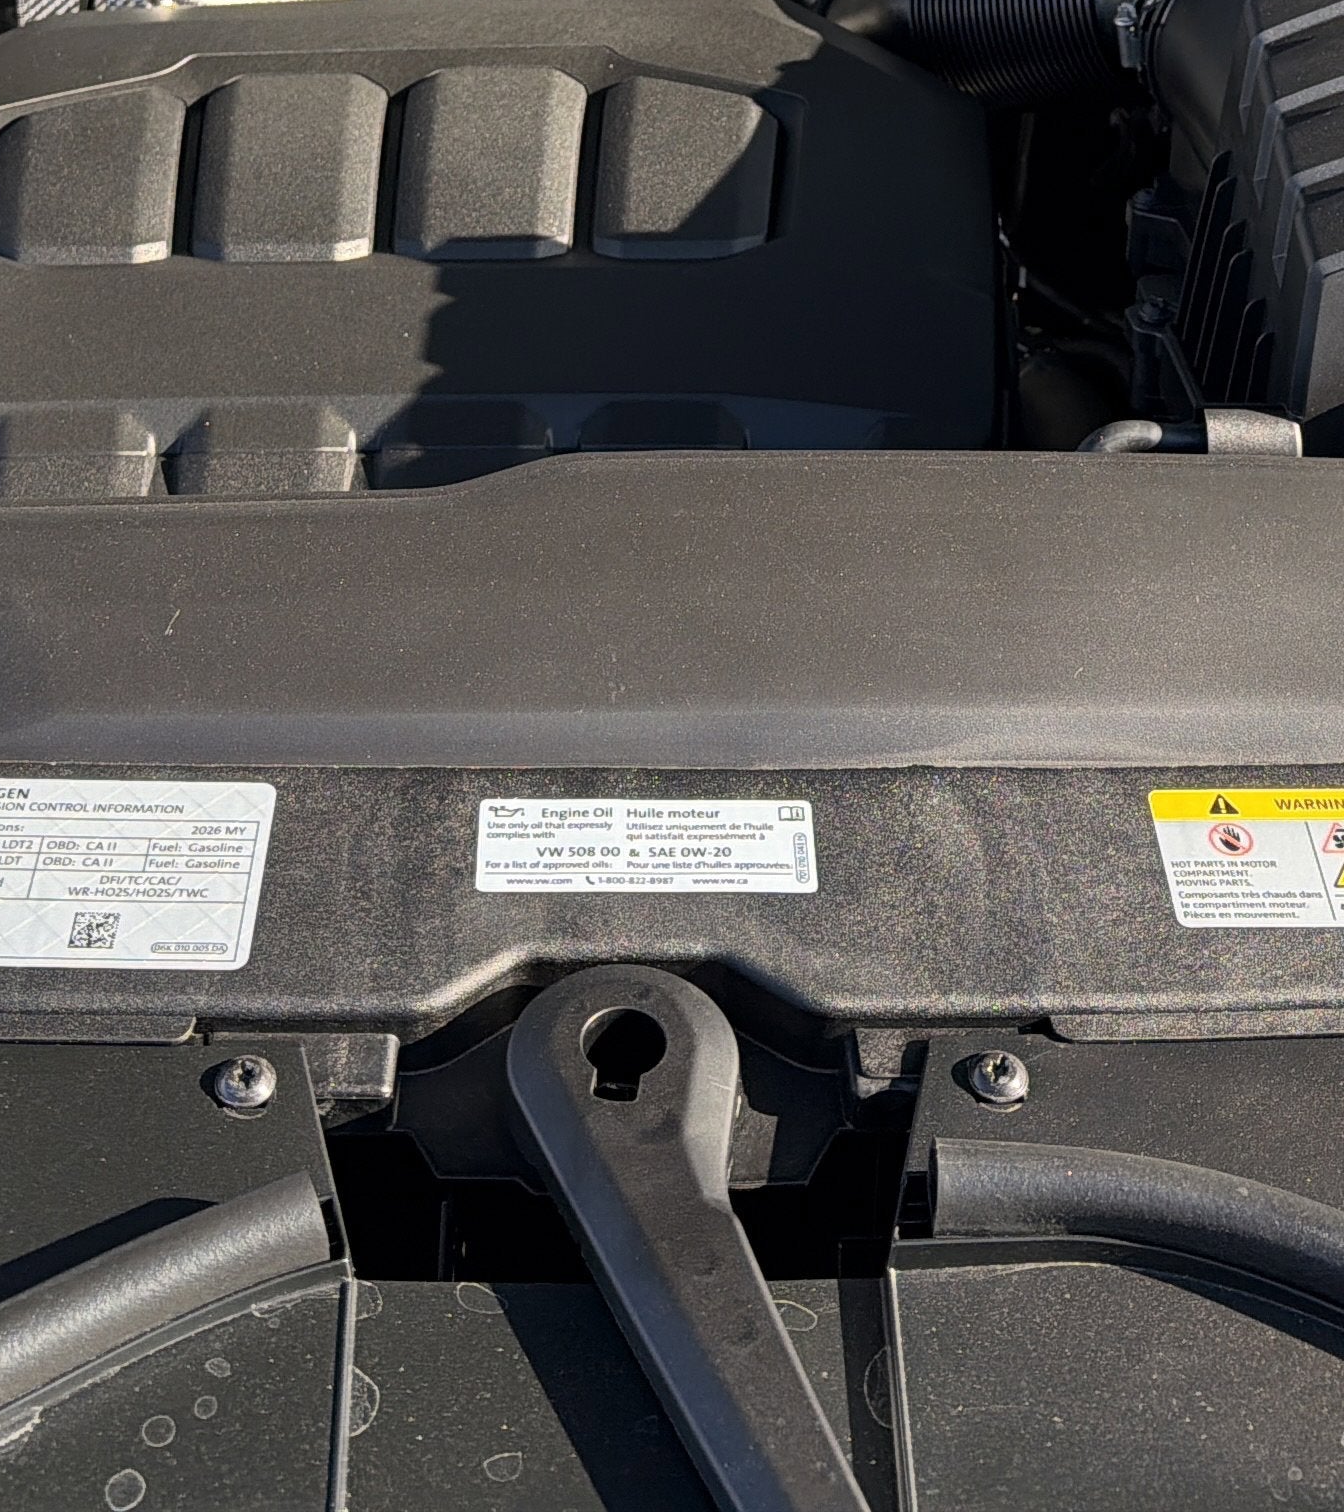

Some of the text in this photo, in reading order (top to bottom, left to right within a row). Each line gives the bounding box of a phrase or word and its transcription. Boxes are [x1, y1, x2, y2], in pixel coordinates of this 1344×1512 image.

[29, 802, 88, 813] CONTROL
[92, 804, 185, 814] INFORMATION
[626, 808, 720, 818] Huile moteur
[542, 807, 613, 820] Engine Oil
[191, 826, 247, 836] 2026 MY
[487, 821, 613, 831] Use only oil that expressly
[626, 823, 664, 831] Utilisez
[665, 823, 727, 832] uniquement
[729, 823, 742, 831] de
[486, 831, 555, 840] complies with
[626, 832, 642, 841] qui
[645, 832, 684, 840] satisfait
[2, 840, 34, 850] LDT2
[46, 841, 81, 851] OBD:
[85, 841, 105, 851] CA
[107, 842, 118, 851] II
[152, 843, 182, 852] Fuel:
[188, 843, 244, 853] Gasoline
[536, 847, 732, 858] VW 508 00 & SAE 0W-20
[42, 857, 76, 867] OBD:
[82, 857, 102, 867] CA
[103, 858, 114, 867] II
[148, 859, 179, 868] Fuel:
[185, 859, 241, 869] Gasoline
[529, 860, 541, 868] of
[542, 861, 589, 870] approved
[626, 861, 649, 869] Pour
[673, 861, 692, 869] liste
[99, 875, 183, 885] DFI/TC/CAC/
[1175, 879, 1217, 887] MOVING
[68, 887, 209, 898] WR-HO2S/HO2S/TWC
[1178, 890, 1323, 900] Composants très chauds dans
[1181, 901, 1190, 909] le
[1193, 901, 1267, 910] compartiment
